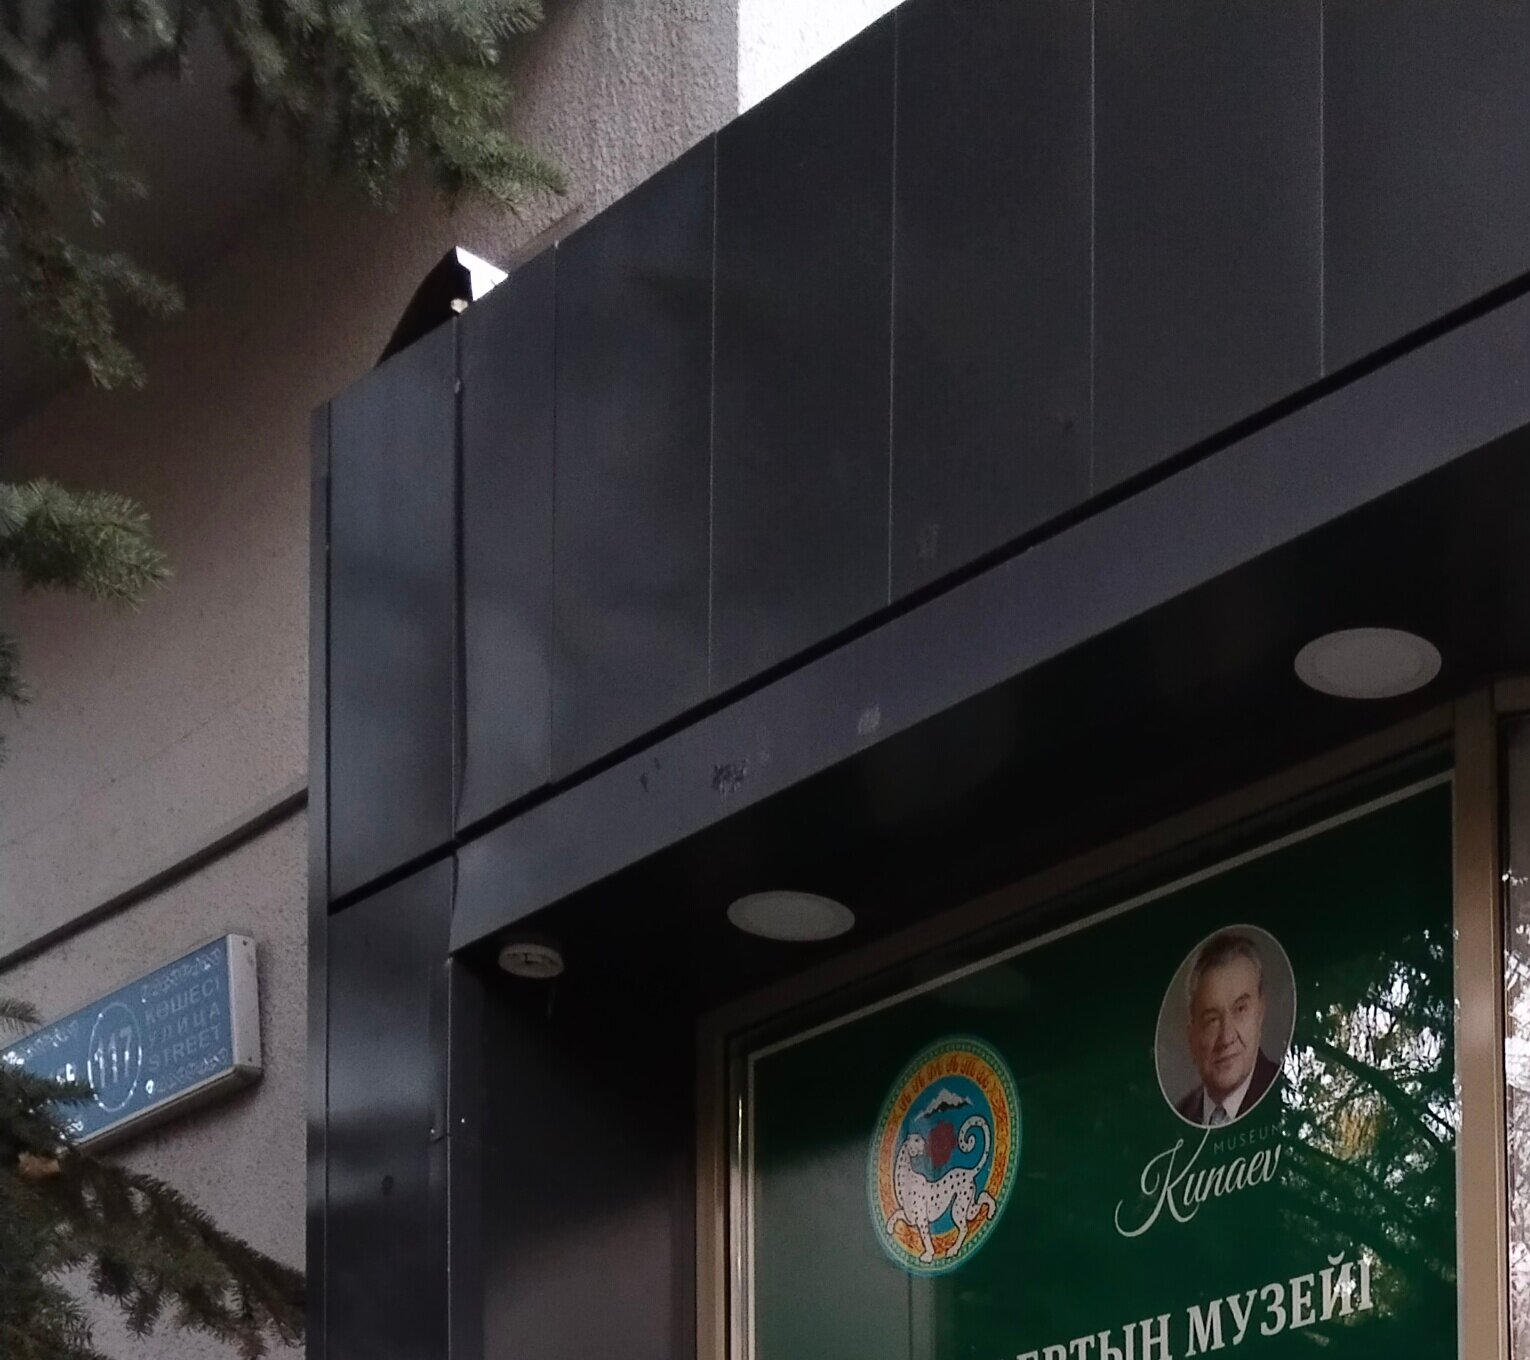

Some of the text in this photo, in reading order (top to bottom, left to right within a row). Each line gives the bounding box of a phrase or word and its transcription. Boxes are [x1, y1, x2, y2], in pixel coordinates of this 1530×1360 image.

[149, 1001, 221, 1049] УЛИЦА
[149, 1023, 220, 1072] STREET
[95, 1026, 132, 1088] 117
[1213, 1124, 1282, 1155] MUSEUM
[1114, 1118, 1282, 1237] Kunaev
[1185, 1250, 1376, 1358] МУЗЕЙІ
